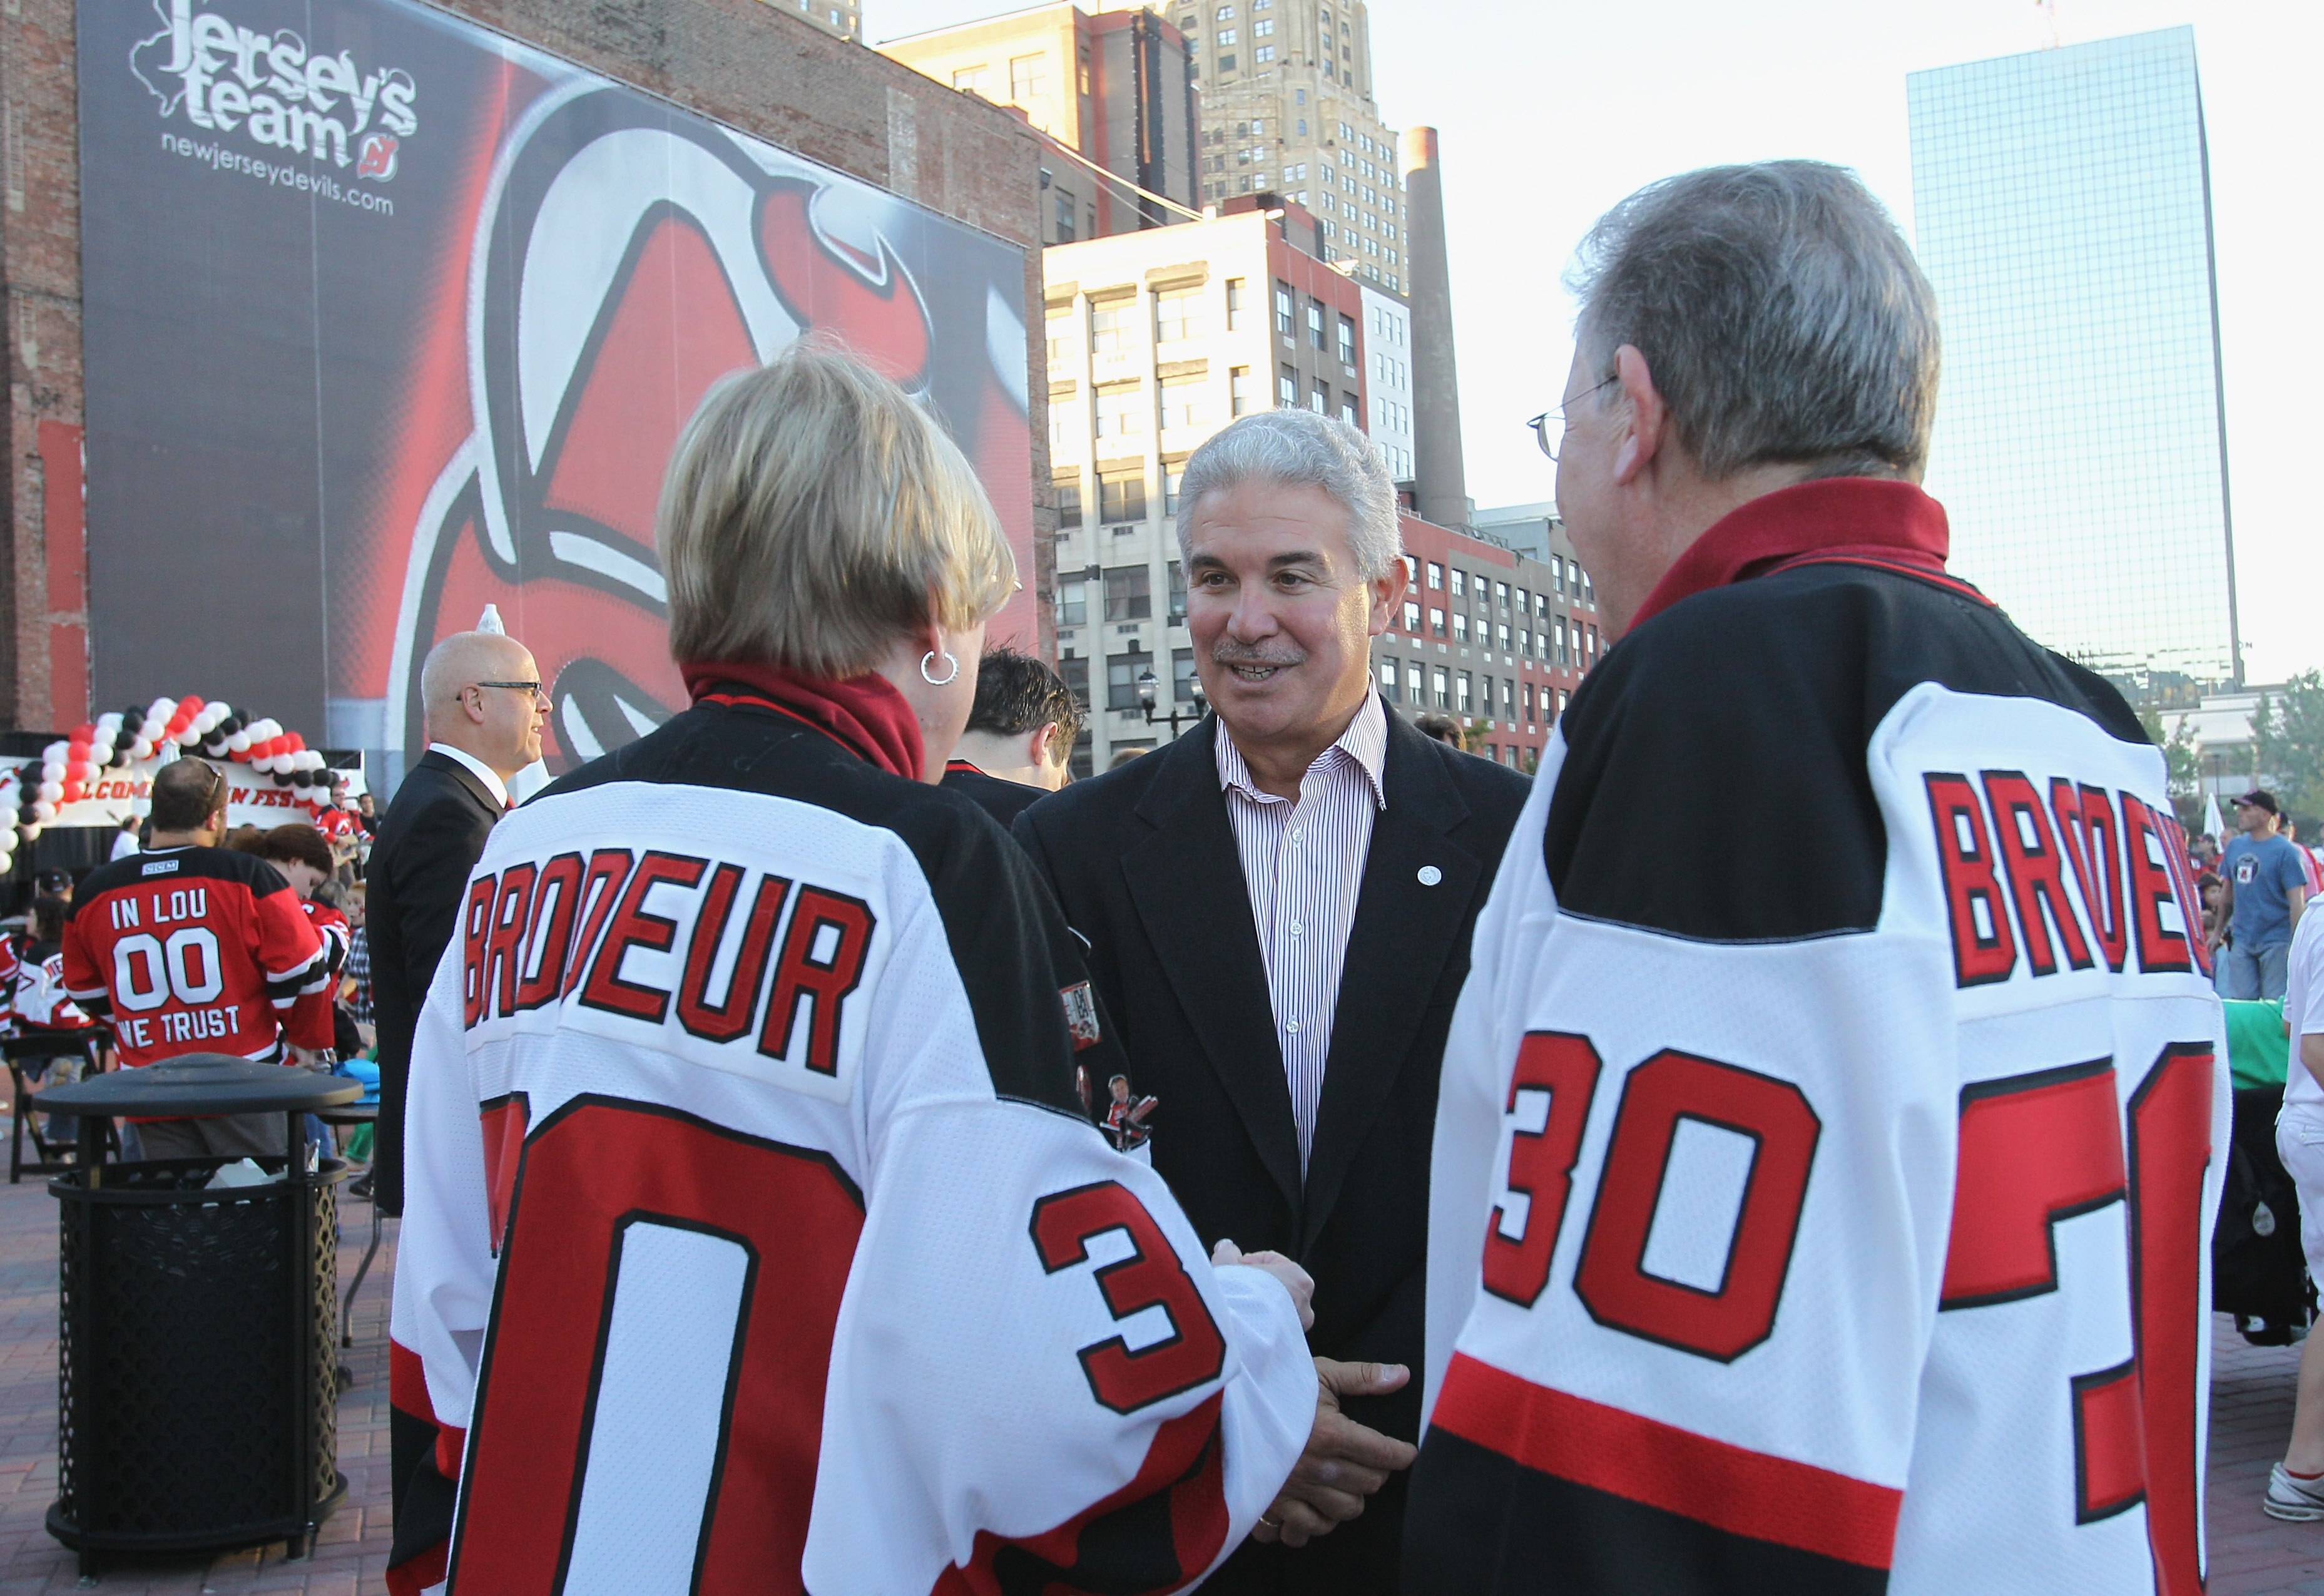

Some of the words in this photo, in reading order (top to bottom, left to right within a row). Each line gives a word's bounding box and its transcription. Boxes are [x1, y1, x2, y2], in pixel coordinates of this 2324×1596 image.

[179, 53, 353, 168] team
[161, 133, 394, 216] newjerseydevils.com
[111, 898, 140, 929] IN
[153, 888, 207, 923] LOU
[113, 927, 223, 1011] 00
[462, 848, 877, 1077] BRODEUR
[160, 1005, 239, 1043] TRUST
[1482, 1030, 1822, 1366] 30
[1029, 1179, 1226, 1416] 3
